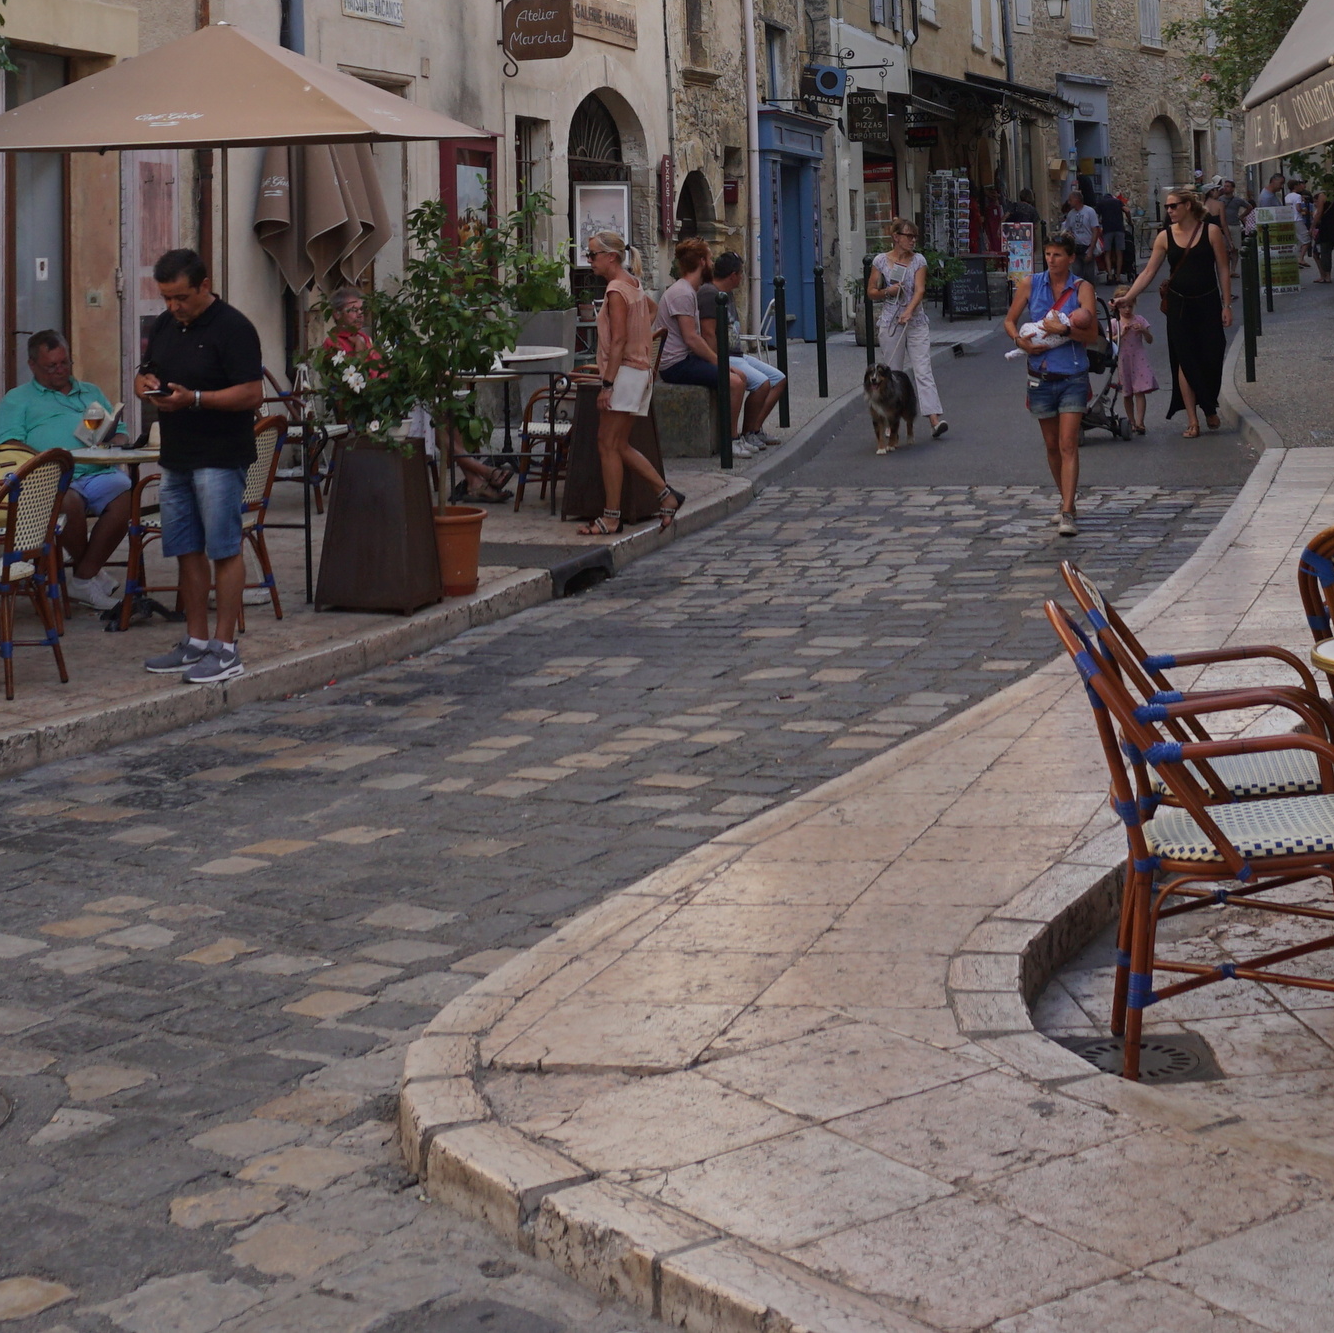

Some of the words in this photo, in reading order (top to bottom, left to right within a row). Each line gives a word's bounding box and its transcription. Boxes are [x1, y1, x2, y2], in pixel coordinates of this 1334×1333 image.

[516, 9, 559, 28] Atelier
[509, 29, 567, 50] Marchal
[803, 93, 840, 105] AGENCE
[862, 106, 875, 120] 2
[855, 121, 883, 129] PIZZAS
[1251, 115, 1263, 147] LE
[848, 132, 887, 140] EMPORTER
